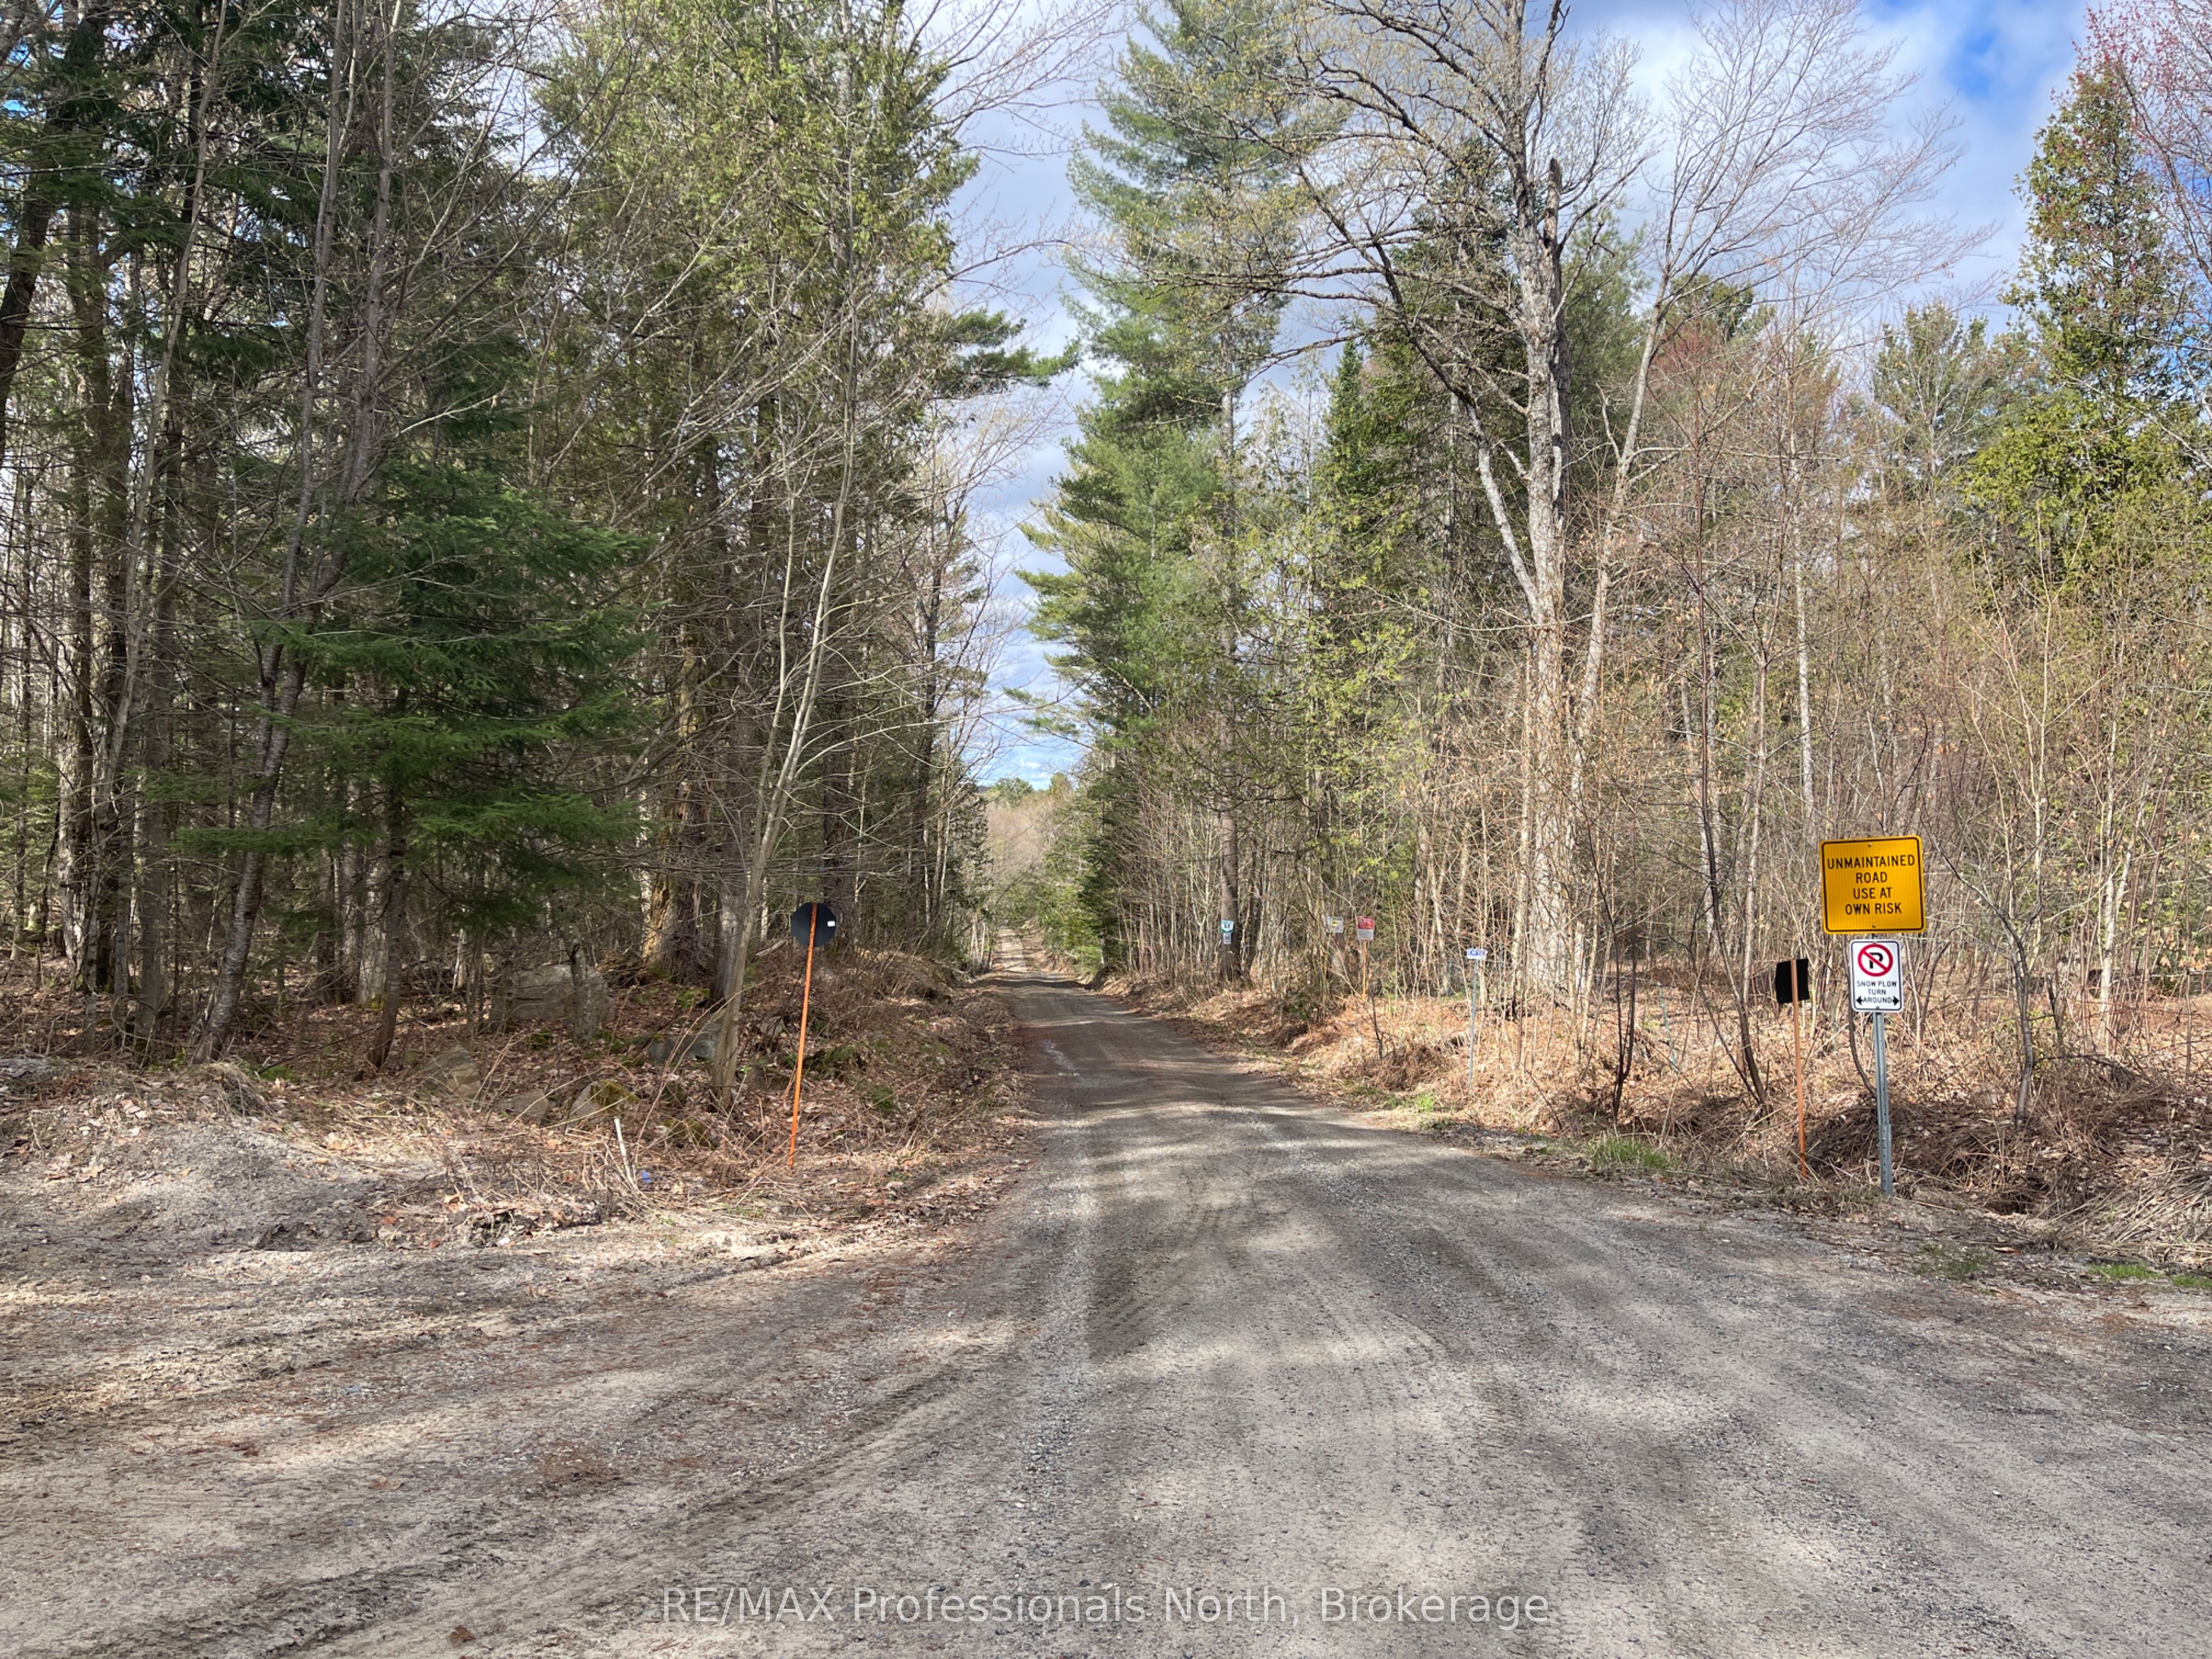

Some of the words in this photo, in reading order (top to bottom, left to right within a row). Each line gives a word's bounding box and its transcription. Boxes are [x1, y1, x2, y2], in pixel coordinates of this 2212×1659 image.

[1827, 854, 1915, 870] UNMAINTAINED
[1855, 872, 1888, 884] ROAD
[1853, 888, 1876, 899] USE
[1880, 887, 1892, 899] AT
[1845, 904, 1870, 915] OWN
[1874, 903, 1902, 914] RISK
